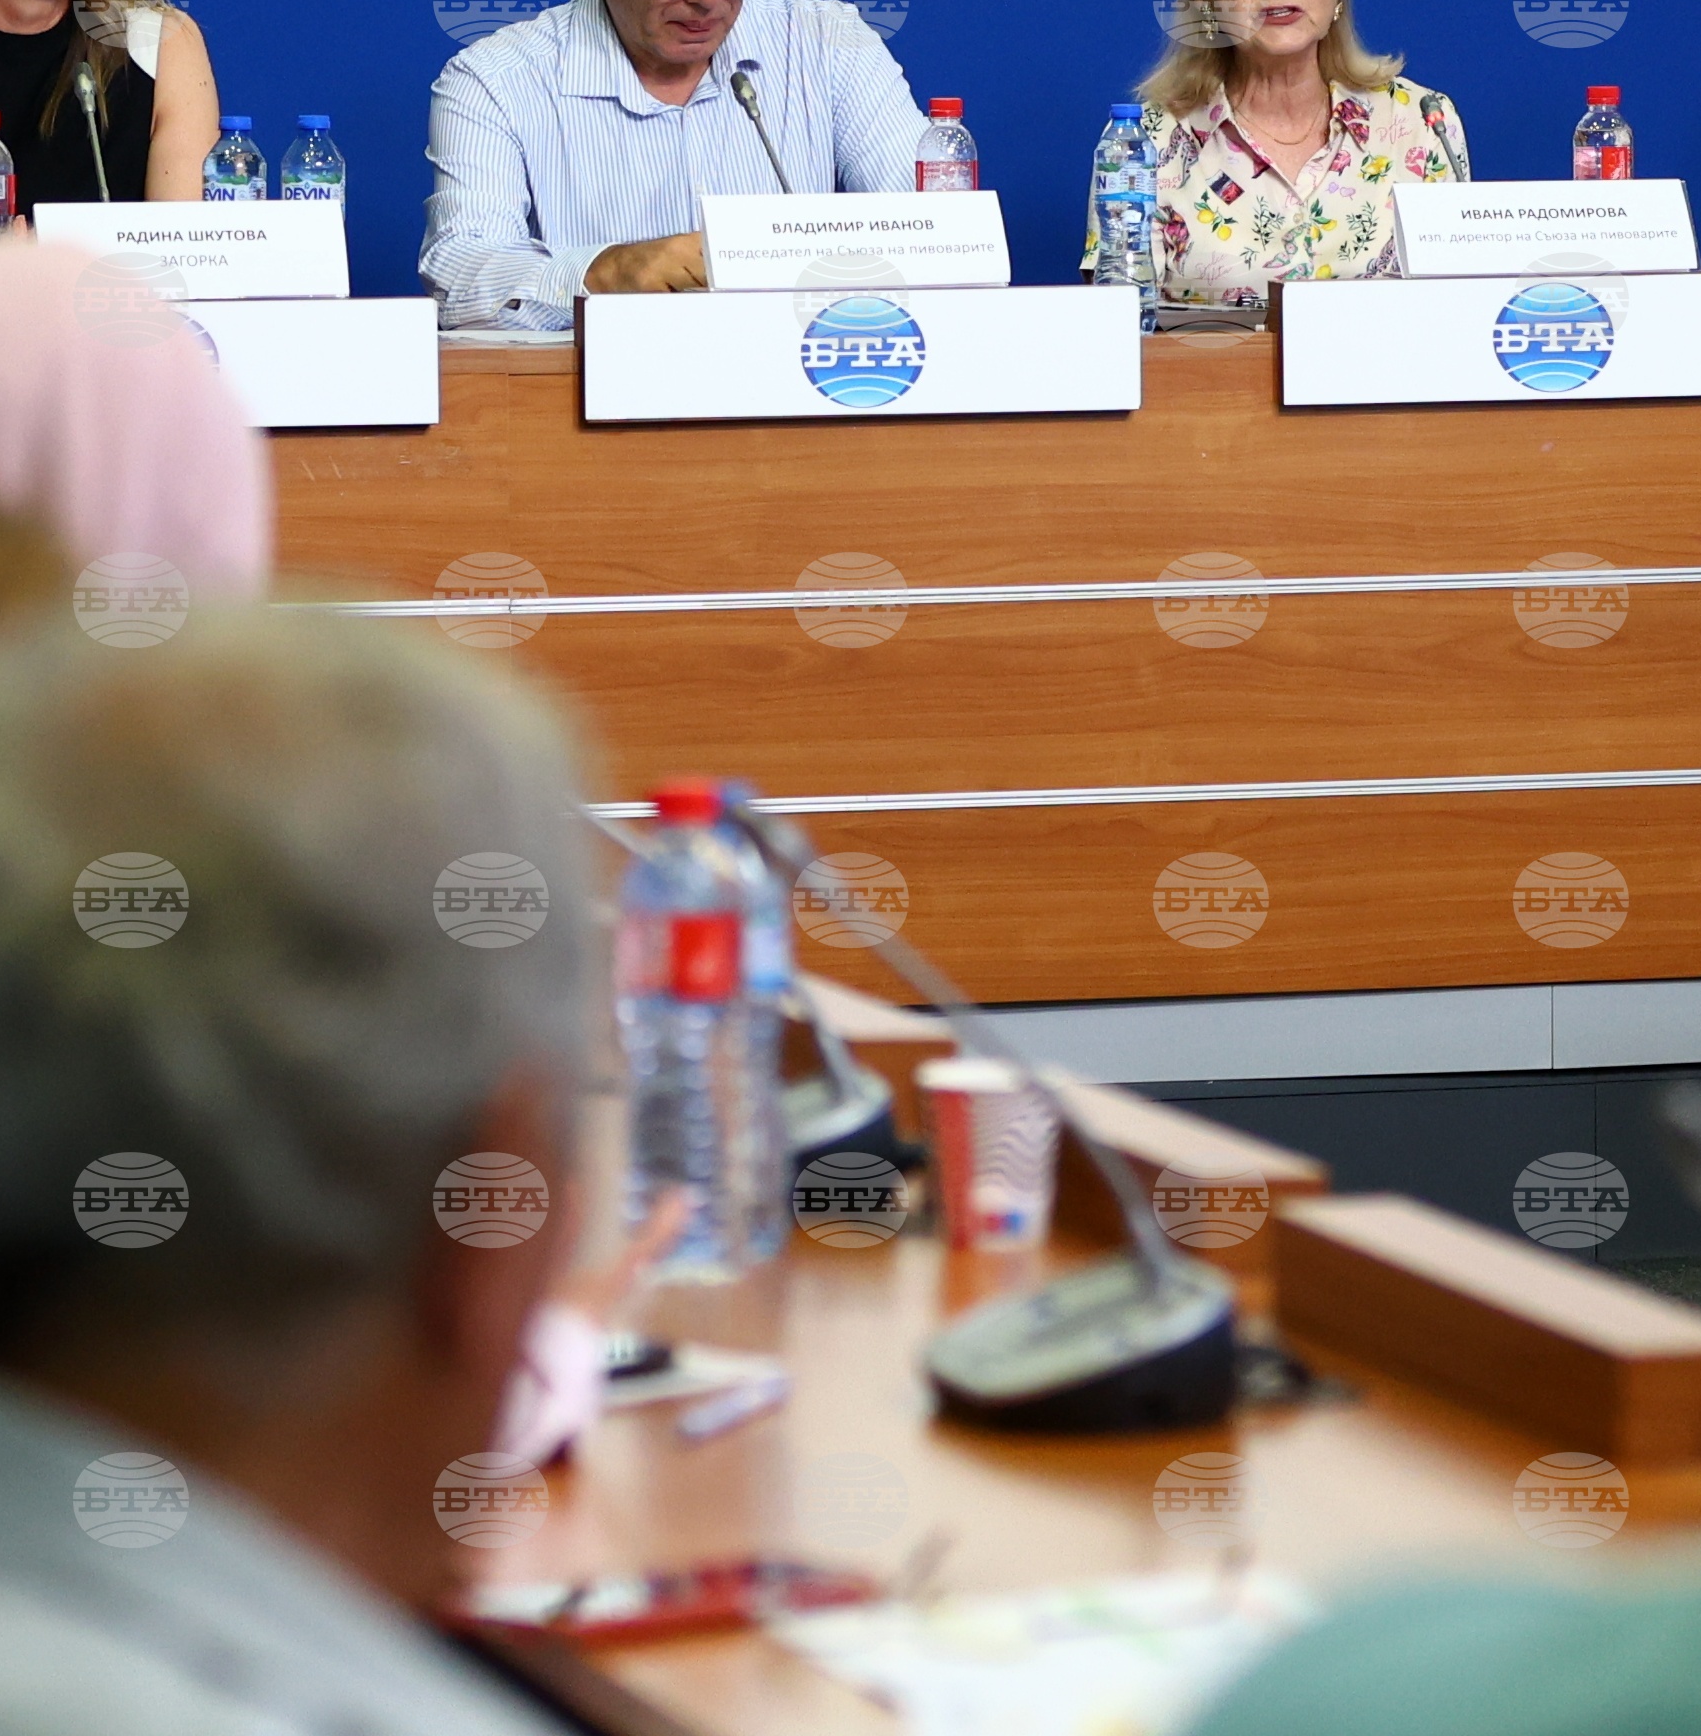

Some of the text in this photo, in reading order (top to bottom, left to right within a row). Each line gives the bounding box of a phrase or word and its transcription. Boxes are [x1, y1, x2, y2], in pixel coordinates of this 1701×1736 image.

[202, 187, 236, 201] EVIN
[284, 187, 331, 201] DEVIN
[1460, 206, 1628, 222] ИВАНА РАДОМИРОВА
[771, 218, 935, 235] ВЛАДИМИР ИВАНОВ
[116, 229, 268, 245] РАДИНА ШКУТОВА
[1418, 227, 1679, 246] изп. директор на Съюза на пивоварите
[717, 240, 996, 262] председател на Съюза на пивоварите
[159, 254, 229, 268] ЗАГОРКА
[1494, 321, 1615, 354] БТА
[801, 336, 927, 368] БТА
